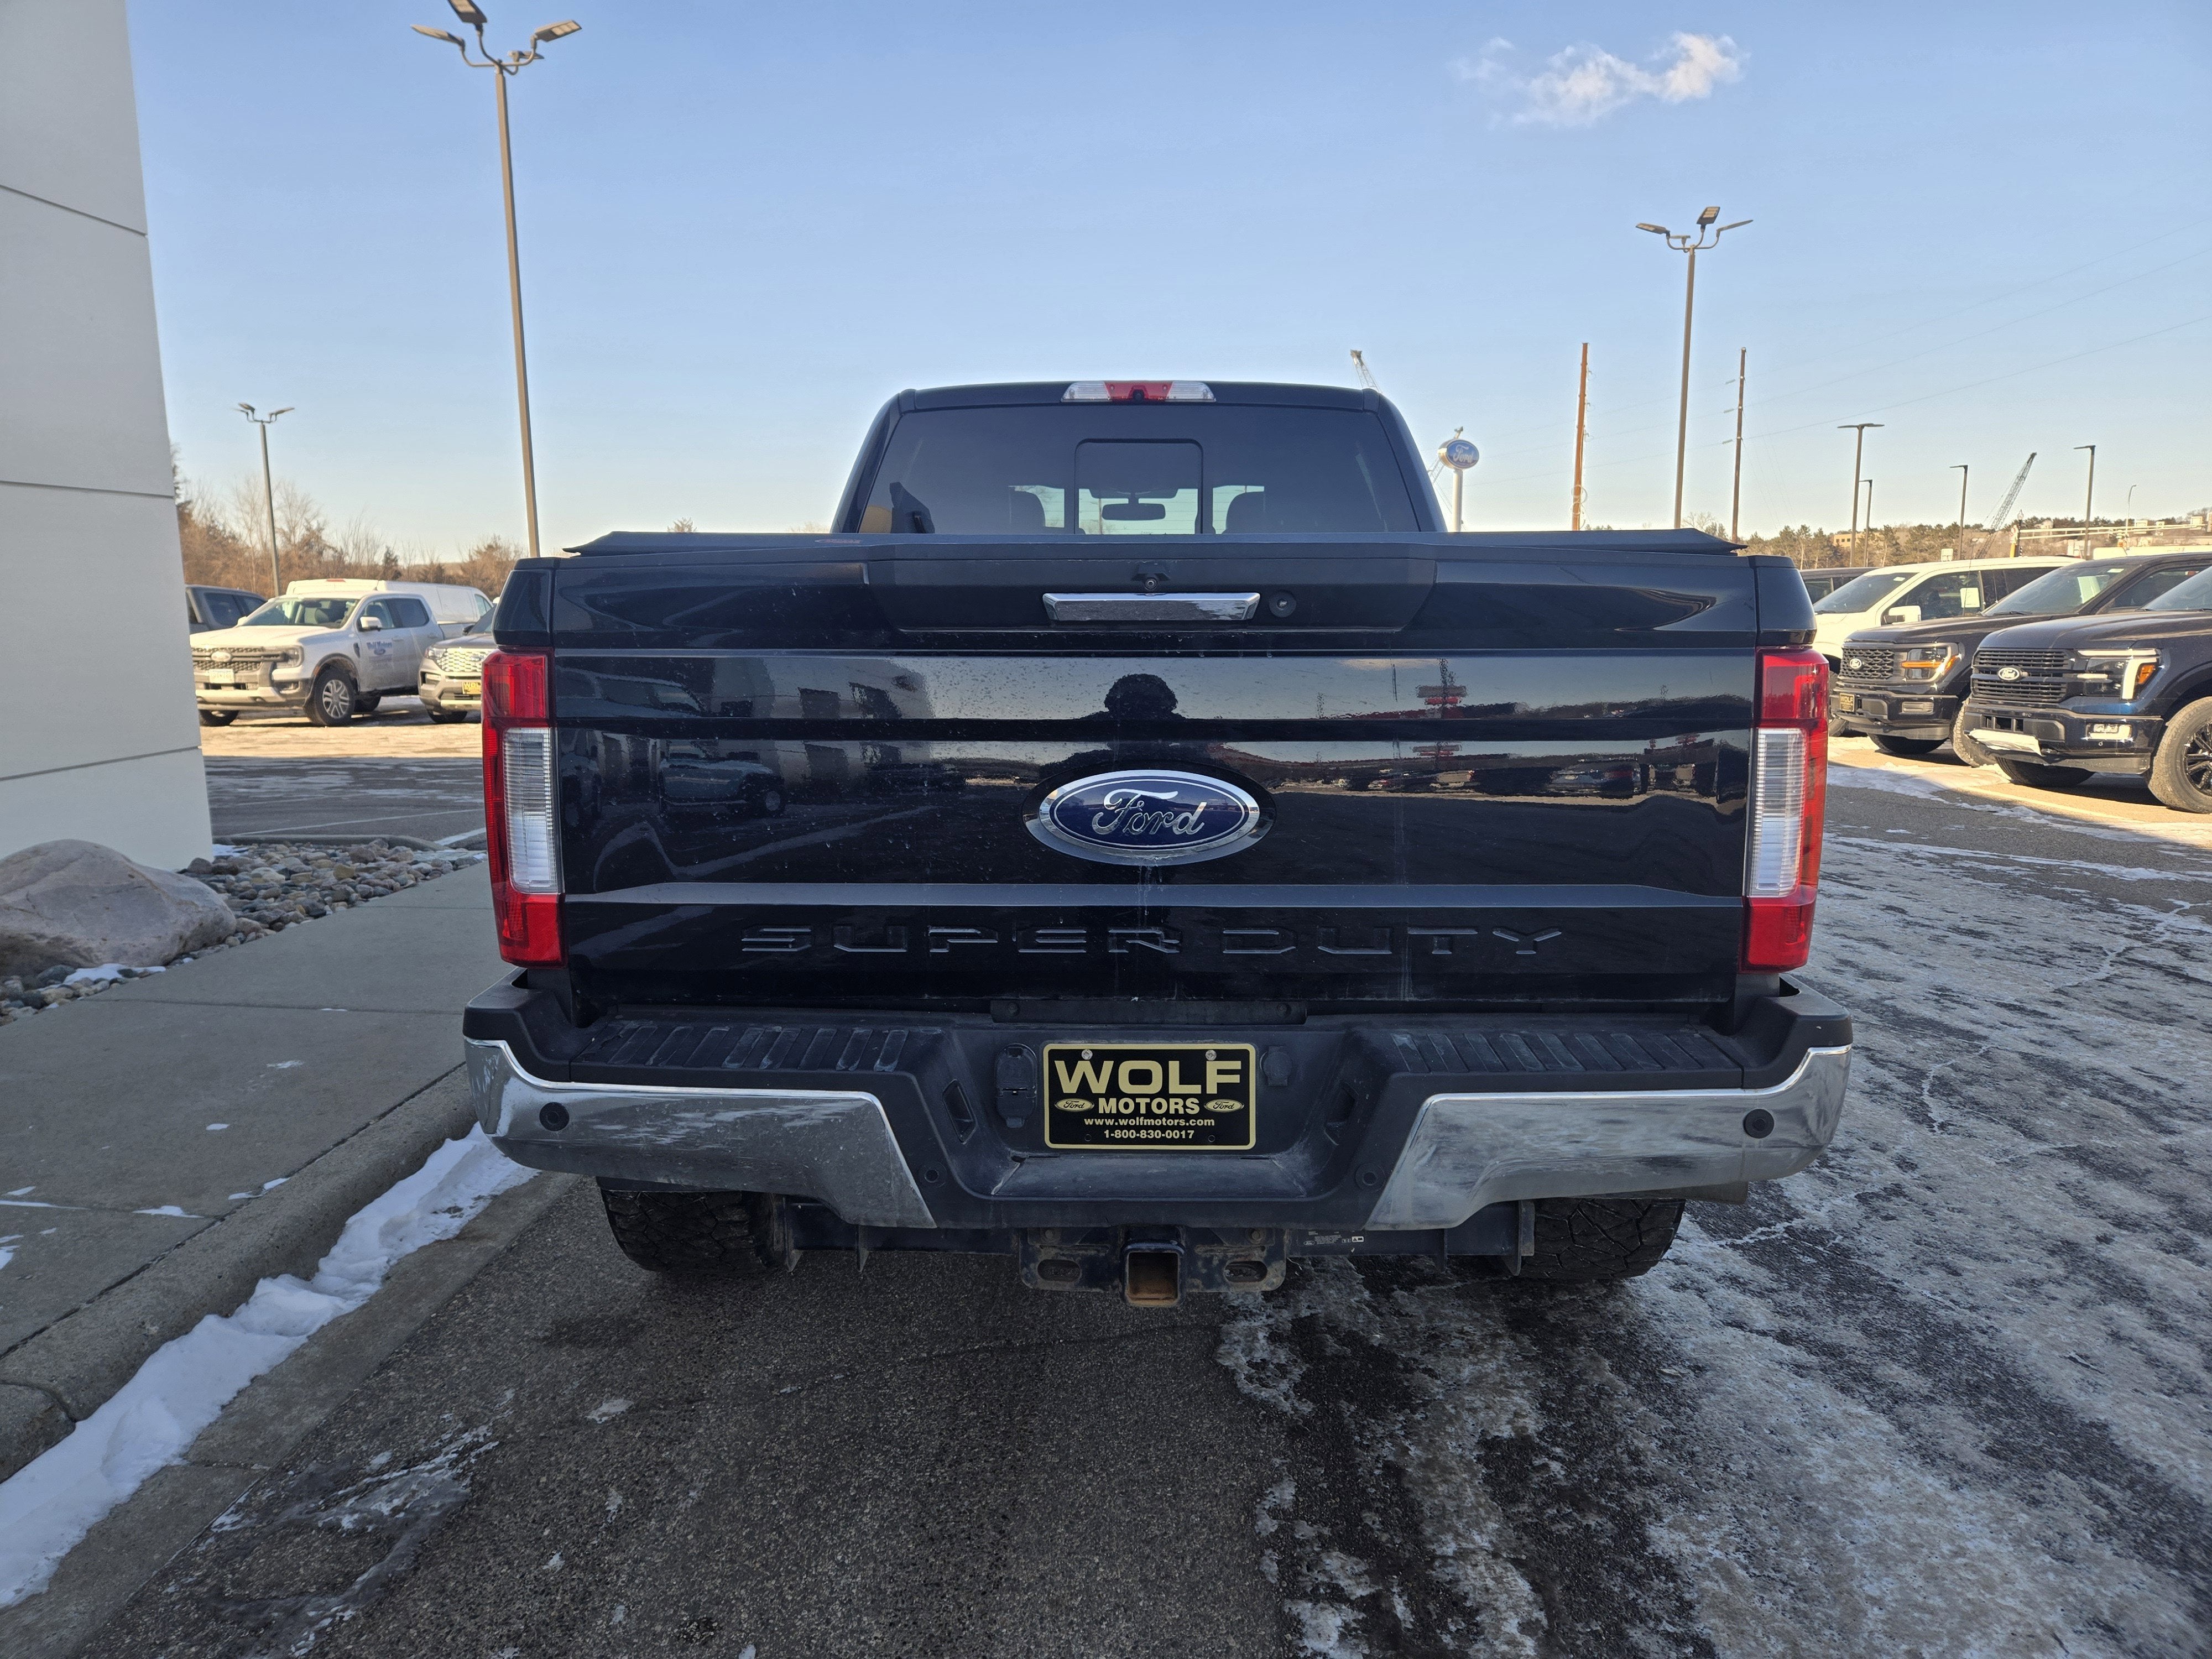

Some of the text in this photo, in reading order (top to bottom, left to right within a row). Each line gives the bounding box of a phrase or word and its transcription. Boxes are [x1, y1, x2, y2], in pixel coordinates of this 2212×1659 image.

[1453, 444, 1474, 463] Ford
[1091, 788, 1208, 836] Ford
[741, 925, 1562, 954] SUPER DUTY
[1054, 1060, 1241, 1094] WOLF
[1063, 1100, 1085, 1109] Ford
[1098, 1098, 1200, 1114] MOTORS
[1213, 1101, 1235, 1109] Ford
[1084, 1117, 1215, 1126] www.wolfmotors.com
[1104, 1129, 1194, 1139] 1-800-830-0017
